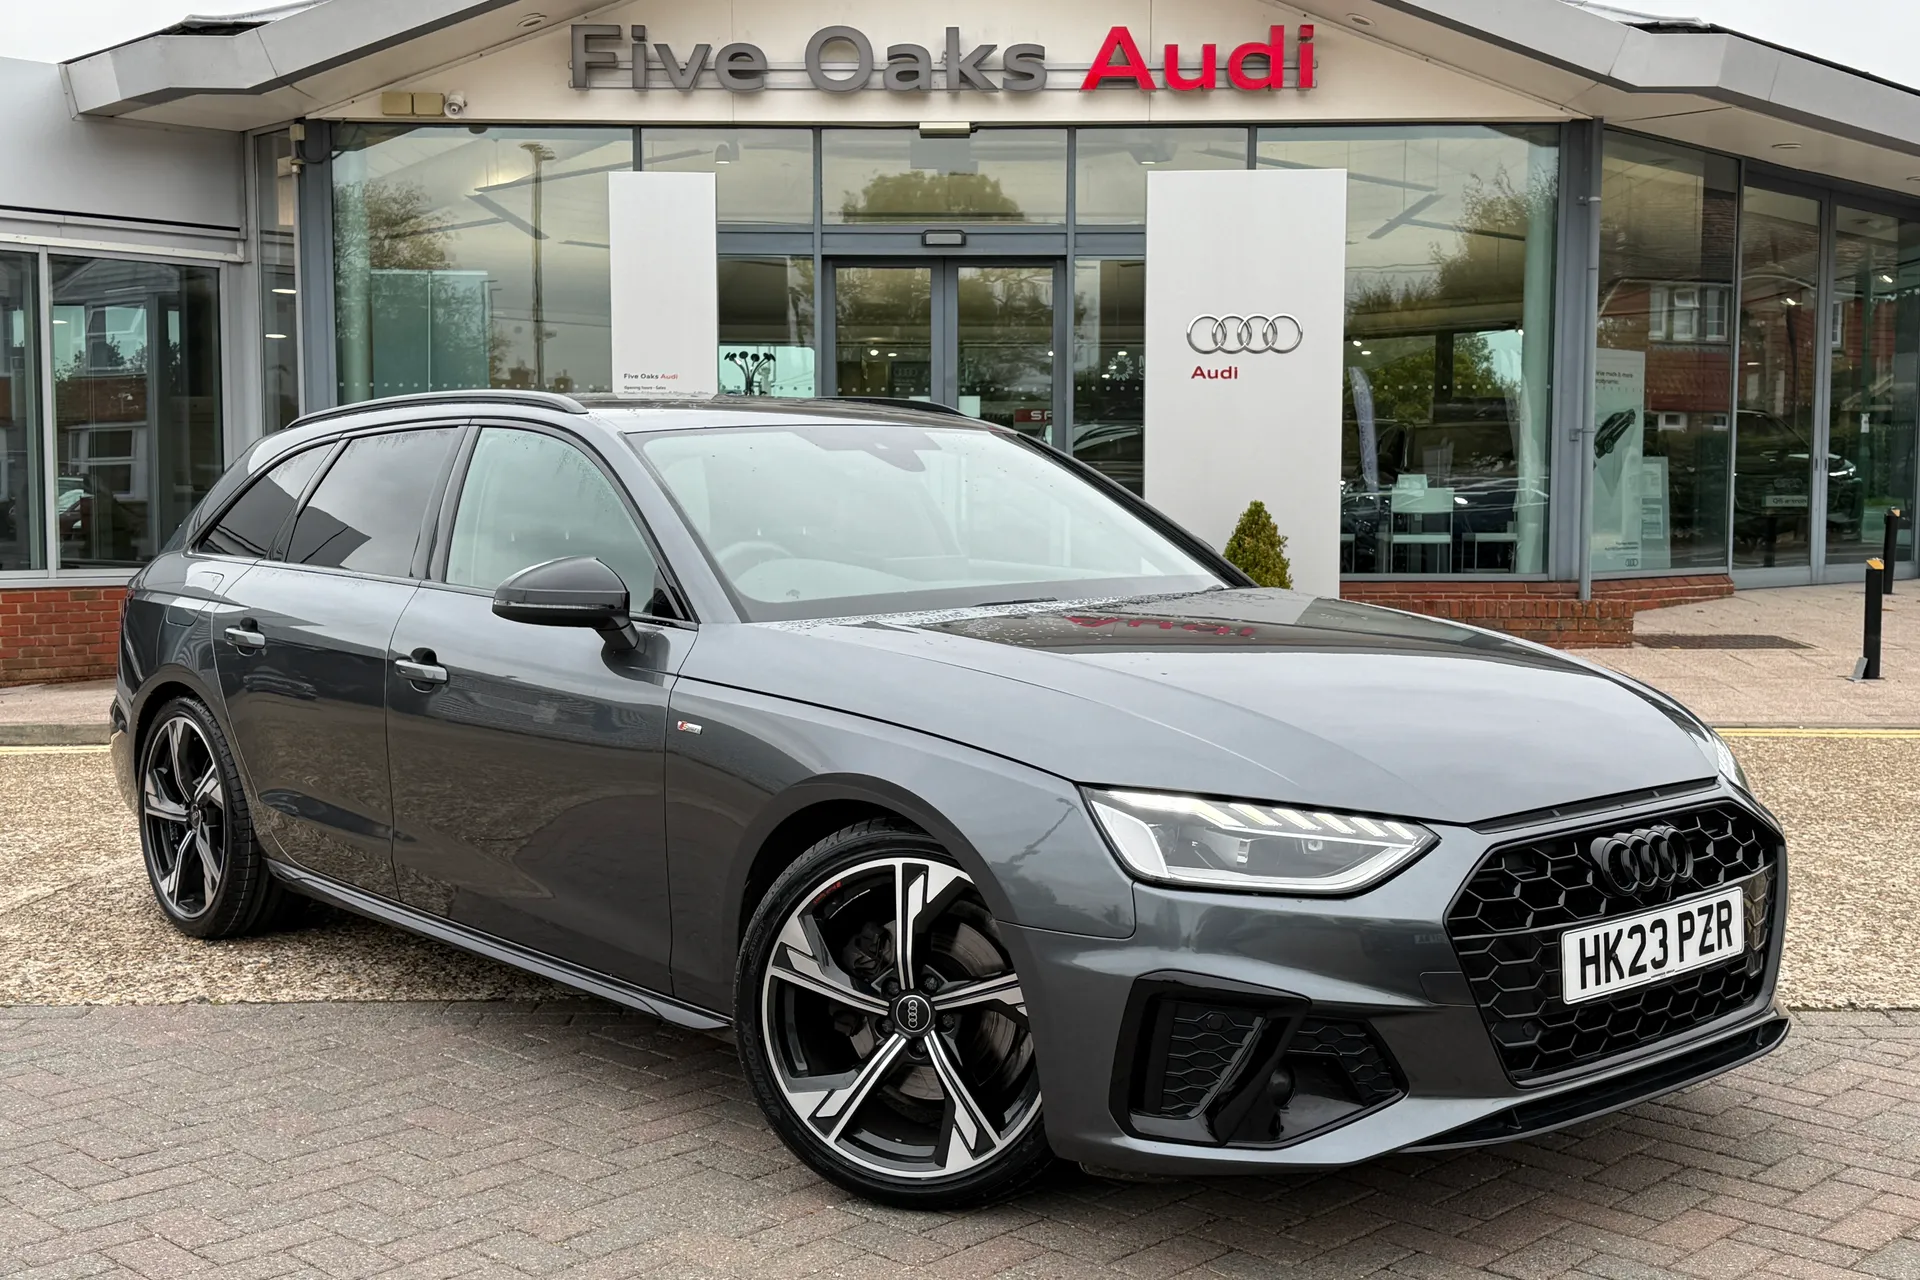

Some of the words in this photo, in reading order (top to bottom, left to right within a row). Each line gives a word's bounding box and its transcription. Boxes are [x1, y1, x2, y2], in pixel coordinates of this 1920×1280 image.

[569, 24, 767, 92] Five
[804, 25, 1047, 93] Oaks
[1080, 24, 1314, 92] Audi
[1191, 366, 1239, 380] Audi
[1579, 918, 1669, 990] HK23
[1677, 899, 1733, 963] PZR
